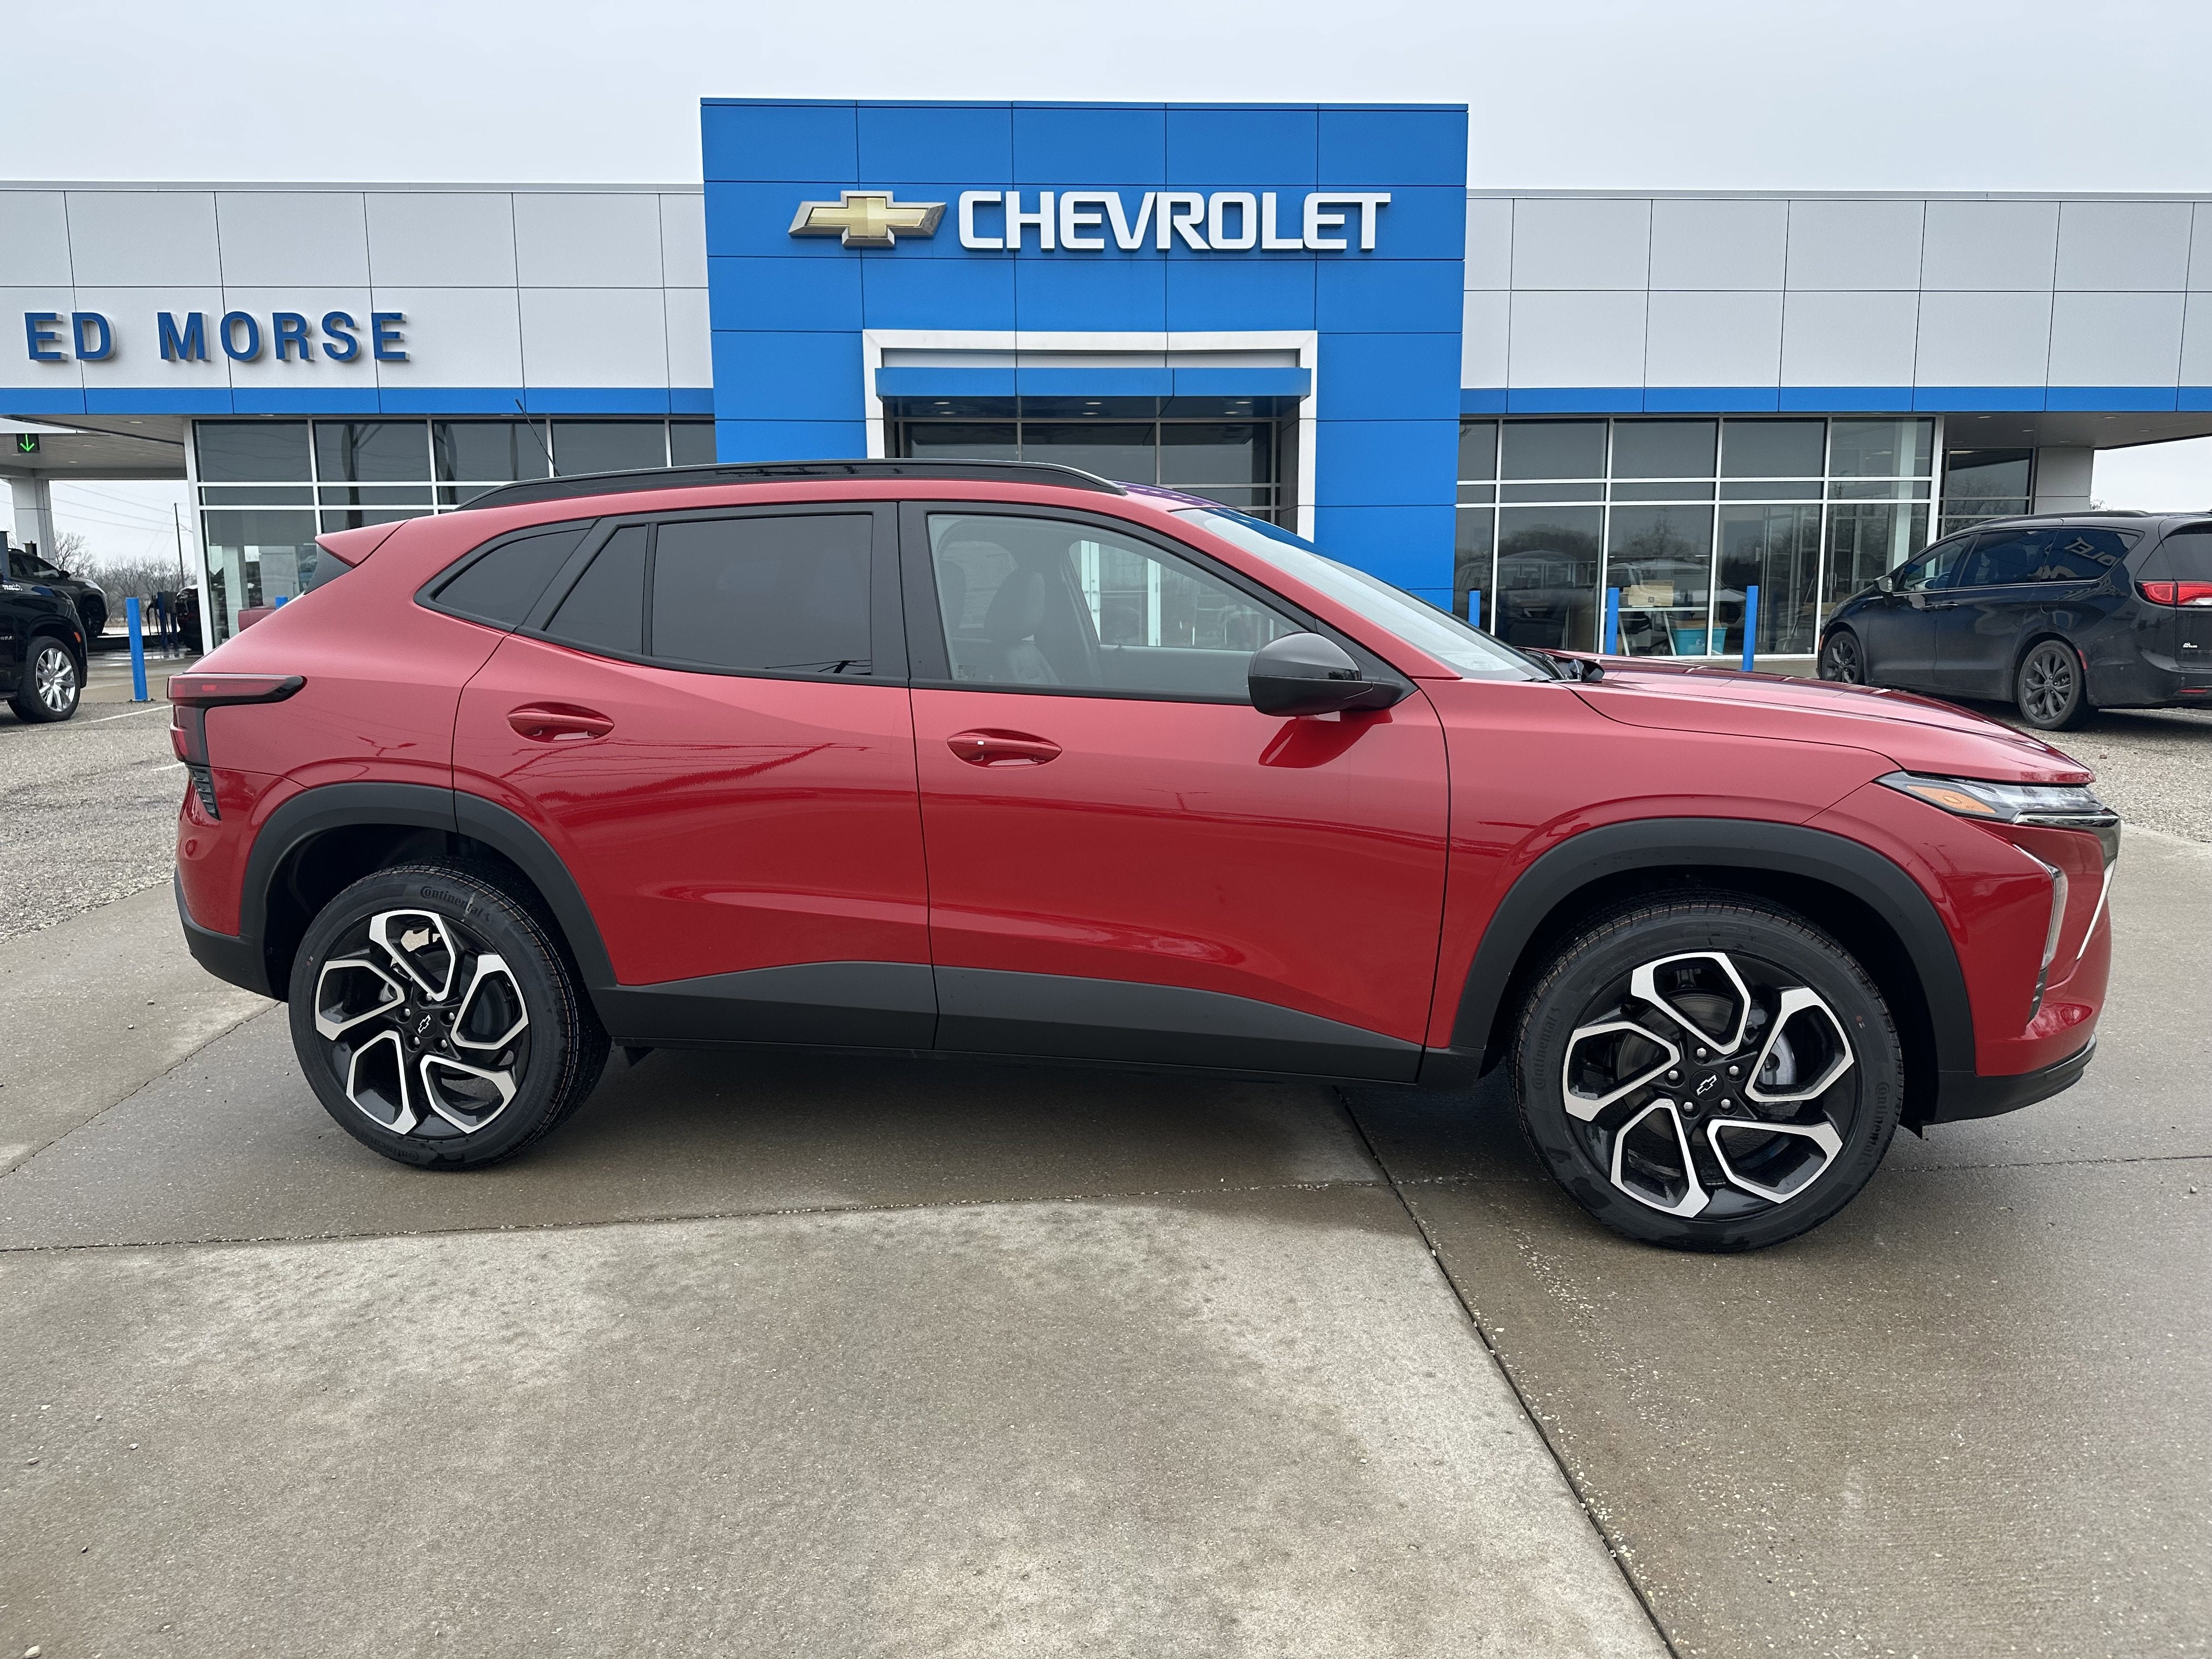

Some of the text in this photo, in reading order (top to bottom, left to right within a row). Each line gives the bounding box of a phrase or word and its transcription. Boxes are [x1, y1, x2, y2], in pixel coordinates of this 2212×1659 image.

[958, 191, 1391, 251] CHEVROLET
[24, 311, 409, 362] ED MORSE
[420, 886, 483, 917] Continental
[1532, 1015, 1558, 1090] Continental
